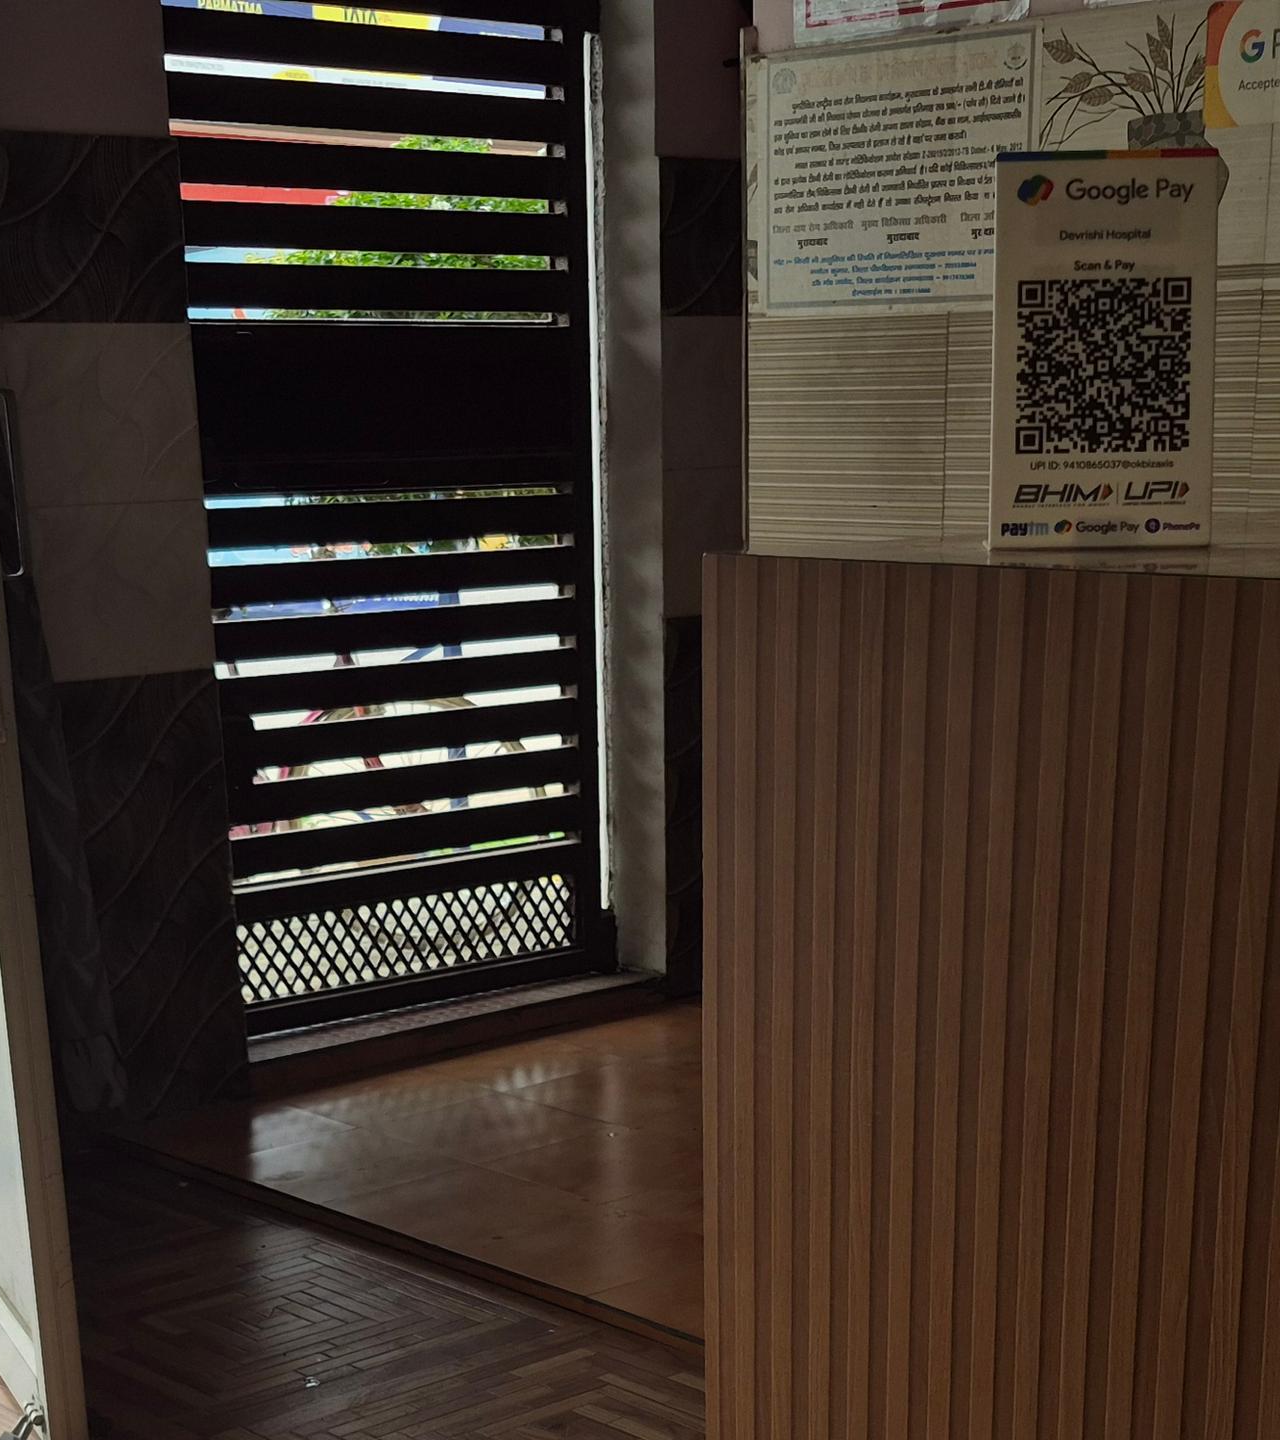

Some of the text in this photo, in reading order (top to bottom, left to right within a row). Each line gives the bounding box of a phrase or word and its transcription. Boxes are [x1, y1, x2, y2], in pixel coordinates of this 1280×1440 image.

[343, 6, 378, 25] TATA
[1066, 178, 1195, 205] Google Pay
[1059, 229, 1152, 242] Devrishi Hospital
[1073, 259, 1135, 273] Scan & Pay
[1030, 461, 1046, 471] UPI
[1048, 461, 1061, 471] ID:
[1014, 481, 1180, 503] BHIM UPI
[1075, 521, 1140, 535] Google Pay
[1163, 522, 1200, 531] PhonePe
